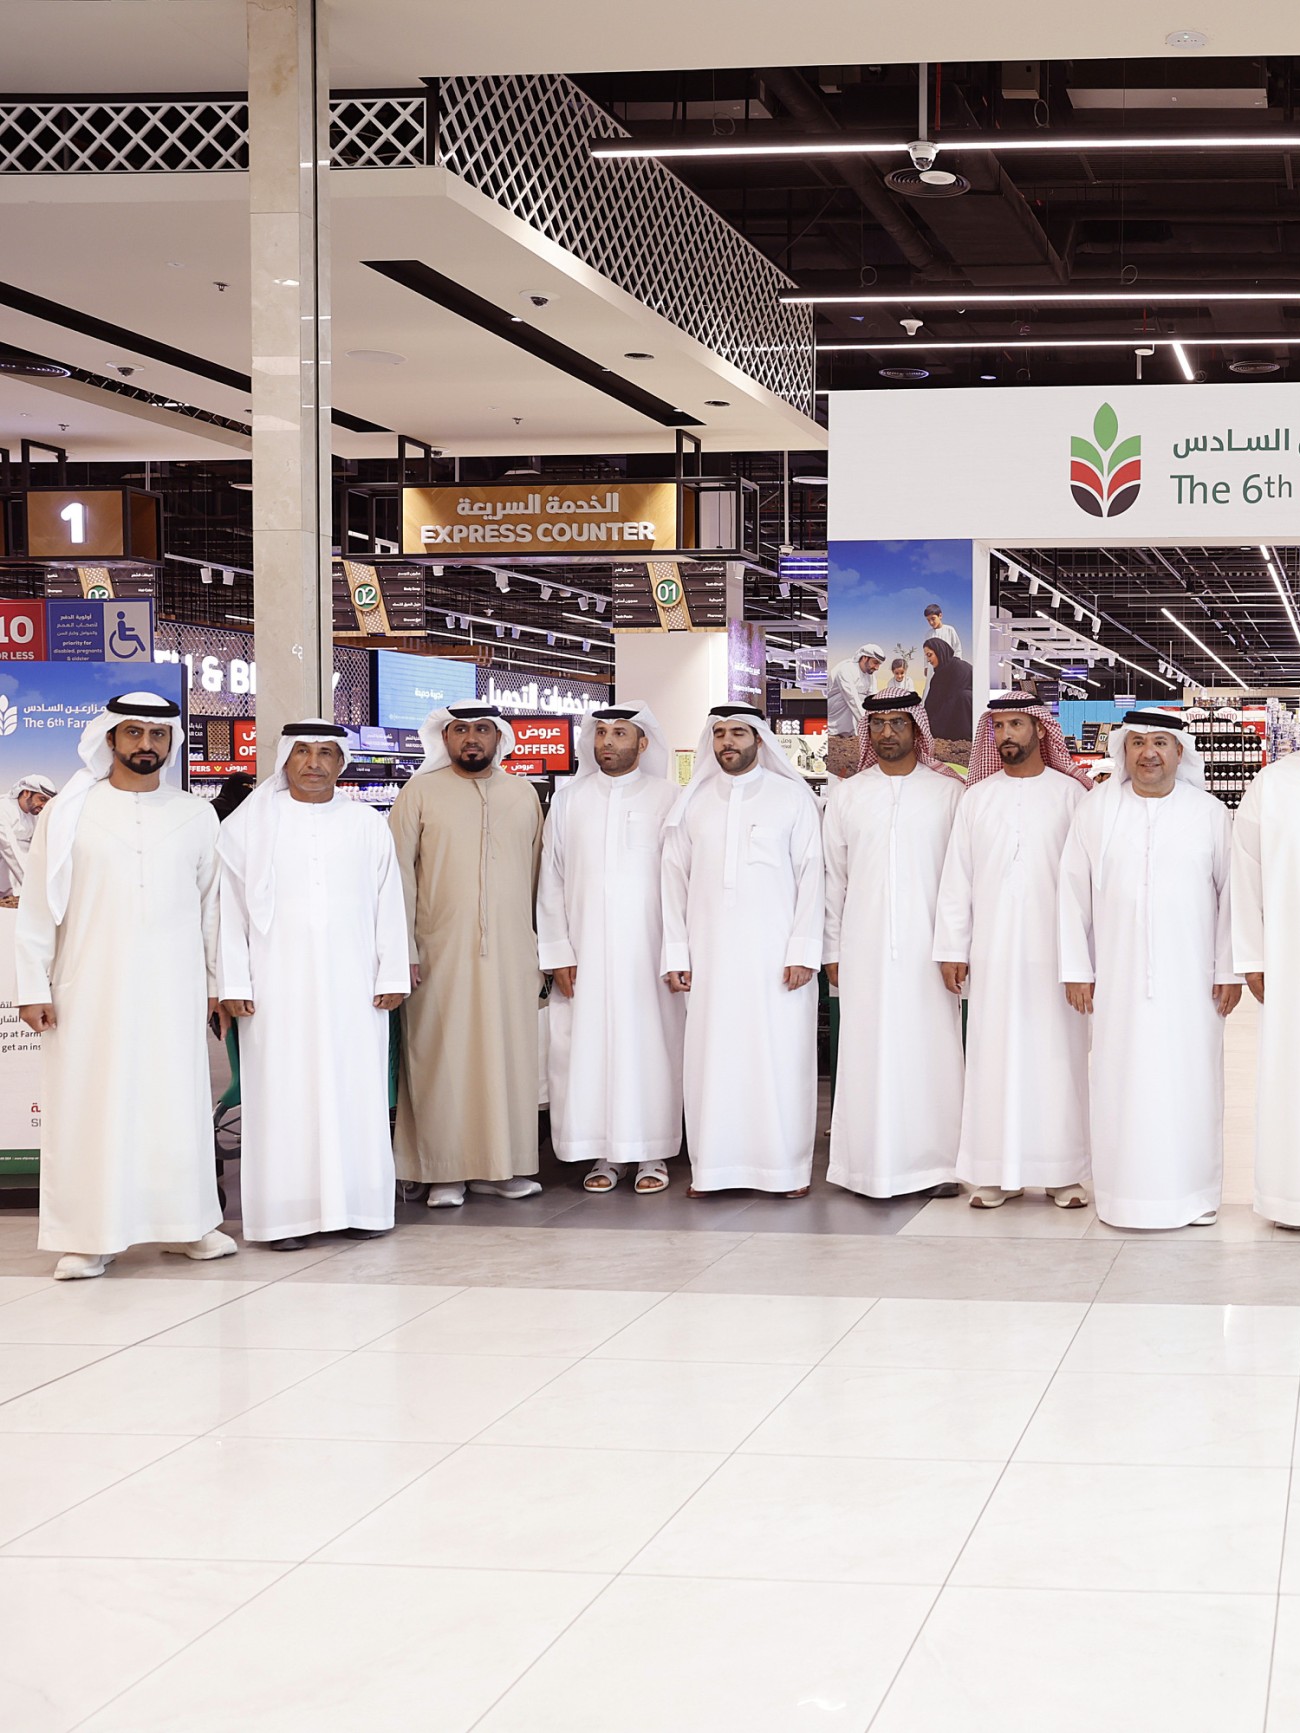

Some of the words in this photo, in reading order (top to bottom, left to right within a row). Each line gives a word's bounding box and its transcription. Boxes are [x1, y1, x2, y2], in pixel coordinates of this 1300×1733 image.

[1173, 428, 1290, 459] السادس
[1170, 474, 1231, 504] The
[1242, 473, 1293, 504] 6th
[456, 493, 541, 521] السريعة
[545, 492, 620, 514] الخدمة
[60, 502, 87, 544] 1
[420, 524, 532, 544] EXPRESS
[536, 521, 656, 542] COUNTER
[354, 587, 376, 606] 02
[656, 583, 677, 602] 01
[10, 652, 35, 660] LESS
[23, 703, 63, 714] السادس
[65, 703, 107, 714] مزارعين
[23, 717, 44, 729] The
[46, 717, 65, 729] 6th
[518, 725, 561, 741] عروض
[514, 743, 565, 755] OFFERS
[10, 1030, 19, 1038] at
[1, 1044, 16, 1054] get
